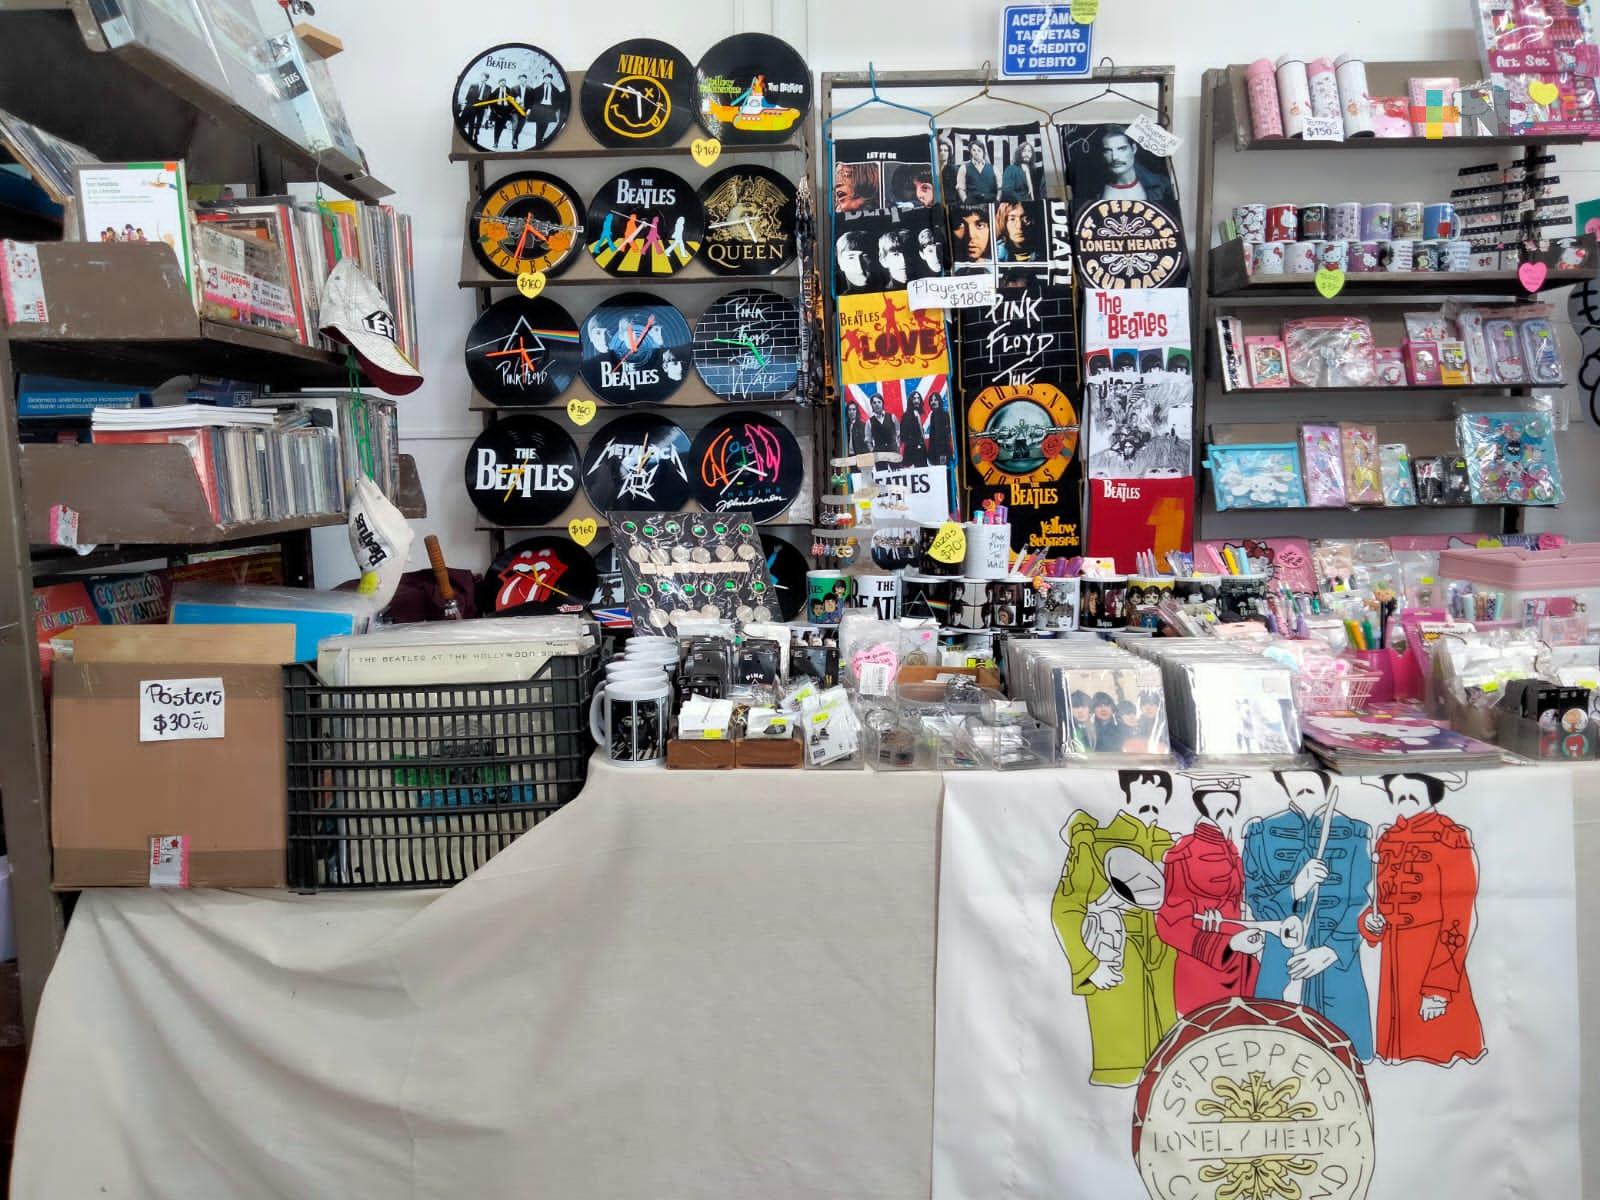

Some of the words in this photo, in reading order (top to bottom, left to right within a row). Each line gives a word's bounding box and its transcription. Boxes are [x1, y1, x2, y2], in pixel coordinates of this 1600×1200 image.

[1011, 12, 1077, 26] ACEPTAM
[1016, 29, 1081, 41] TARJETAS
[1008, 44, 1026, 55] DE
[1029, 42, 1086, 55] CREDITO
[486, 55, 517, 70] BEATLES
[617, 54, 675, 81] NIRVANA
[1017, 58, 1026, 68] Y
[1029, 57, 1076, 68] DEBITO
[499, 178, 548, 202] GUNS
[616, 178, 677, 209] BEATLES
[640, 178, 654, 186] THE
[1098, 200, 1175, 239] PEPPERS
[707, 243, 785, 269] QUEEN
[1080, 239, 1124, 253] LONELY
[1126, 238, 1177, 252] HEARTS
[1086, 258, 1126, 290] CLUB
[1130, 255, 1175, 290] BAND
[912, 279, 978, 299] Playeras
[950, 291, 985, 307] $180
[726, 298, 770, 323] PINK
[985, 289, 1043, 329] PINK
[1095, 291, 1122, 316] The
[840, 311, 880, 328] BEATLES
[861, 328, 938, 361] LOVE
[985, 320, 1054, 364] FLOYD
[600, 361, 660, 391] BEATLES
[622, 361, 637, 372] THE
[514, 447, 537, 459] THE
[474, 448, 575, 498] BEATLES
[1010, 484, 1059, 509] BEATLES
[1103, 480, 1141, 502] BEATLES
[572, 525, 594, 536] $160
[1040, 515, 1077, 536] Yellow
[354, 512, 388, 567] BEATLES
[876, 580, 896, 593] THE
[1189, 1040, 1346, 1112] PEPPERS
[1153, 1126, 1252, 1154] LONELY
[1264, 1121, 1362, 1150] HEARTS
